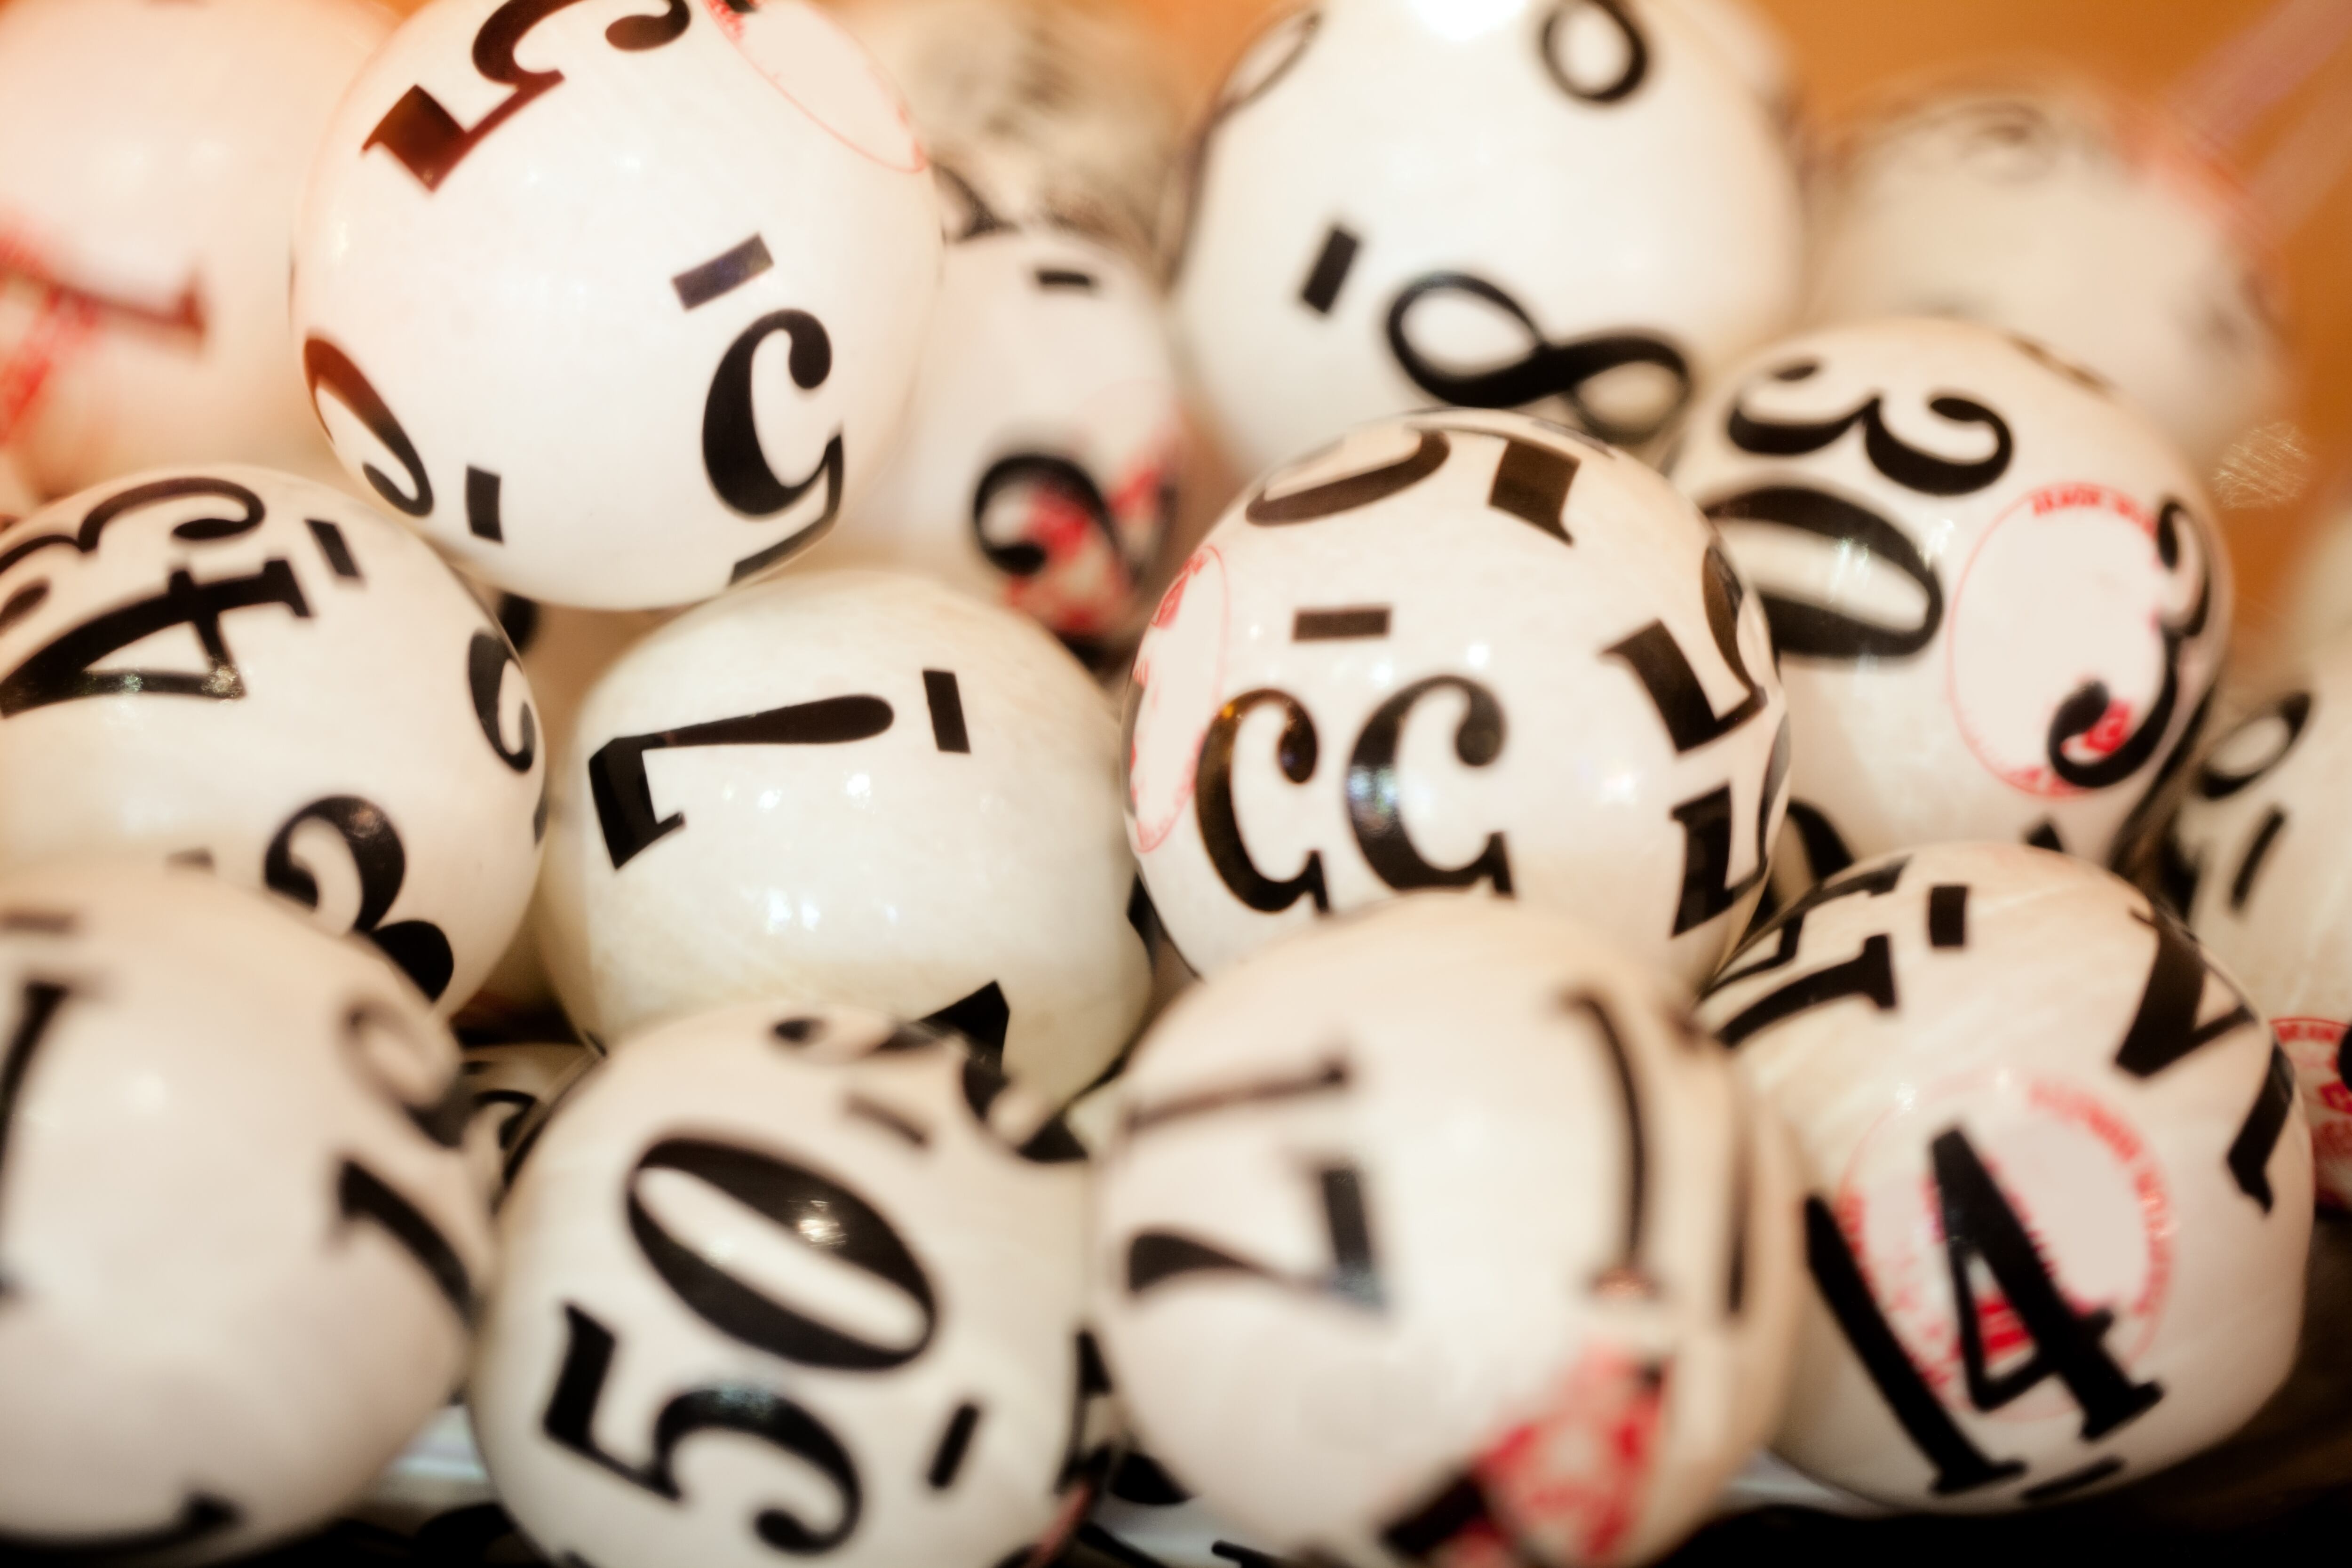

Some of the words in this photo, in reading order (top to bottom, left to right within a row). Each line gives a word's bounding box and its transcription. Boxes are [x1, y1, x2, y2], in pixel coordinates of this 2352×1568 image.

[701, 307, 845, 588] 5
[1385, 269, 1692, 445] 8
[1700, 360, 2013, 664] 30
[588, 693, 895, 871] 7
[543, 1133, 935, 1555] 50
[1803, 1122, 2165, 1496] 14
